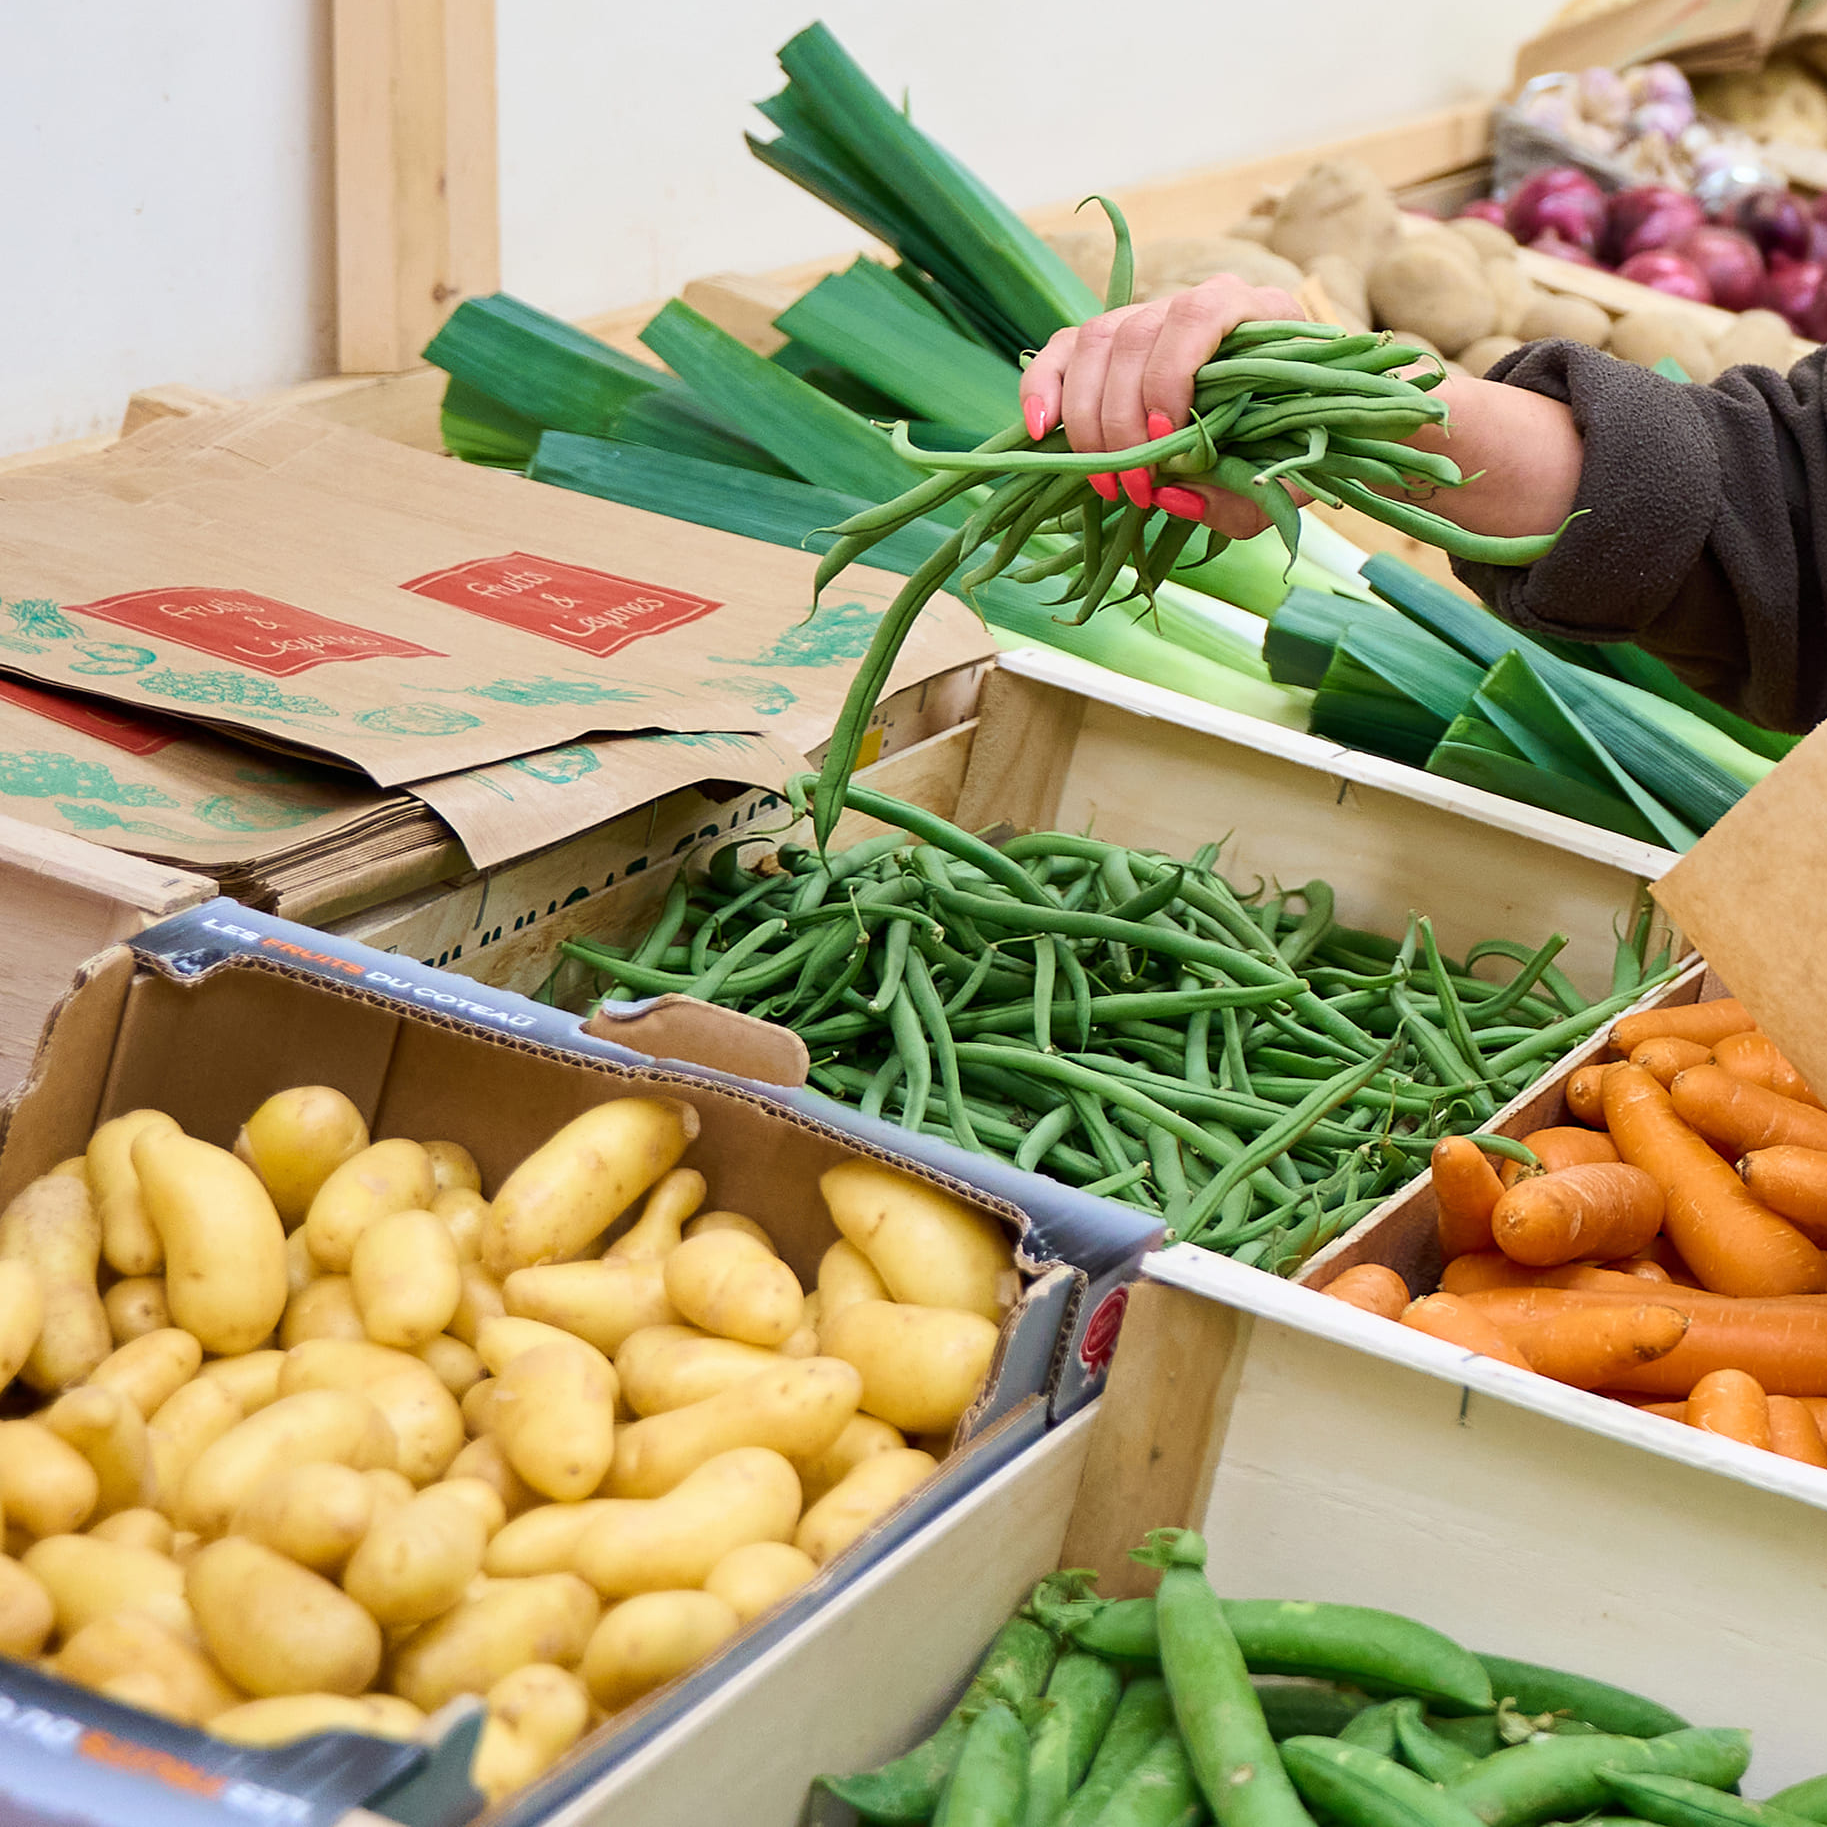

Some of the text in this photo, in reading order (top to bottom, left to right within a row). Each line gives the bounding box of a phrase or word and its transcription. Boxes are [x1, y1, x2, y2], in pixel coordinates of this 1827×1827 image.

[467, 570, 552, 599] Fruits
[540, 592, 583, 609] &
[202, 918, 539, 1027] LES FRUITS DU COTEAU
